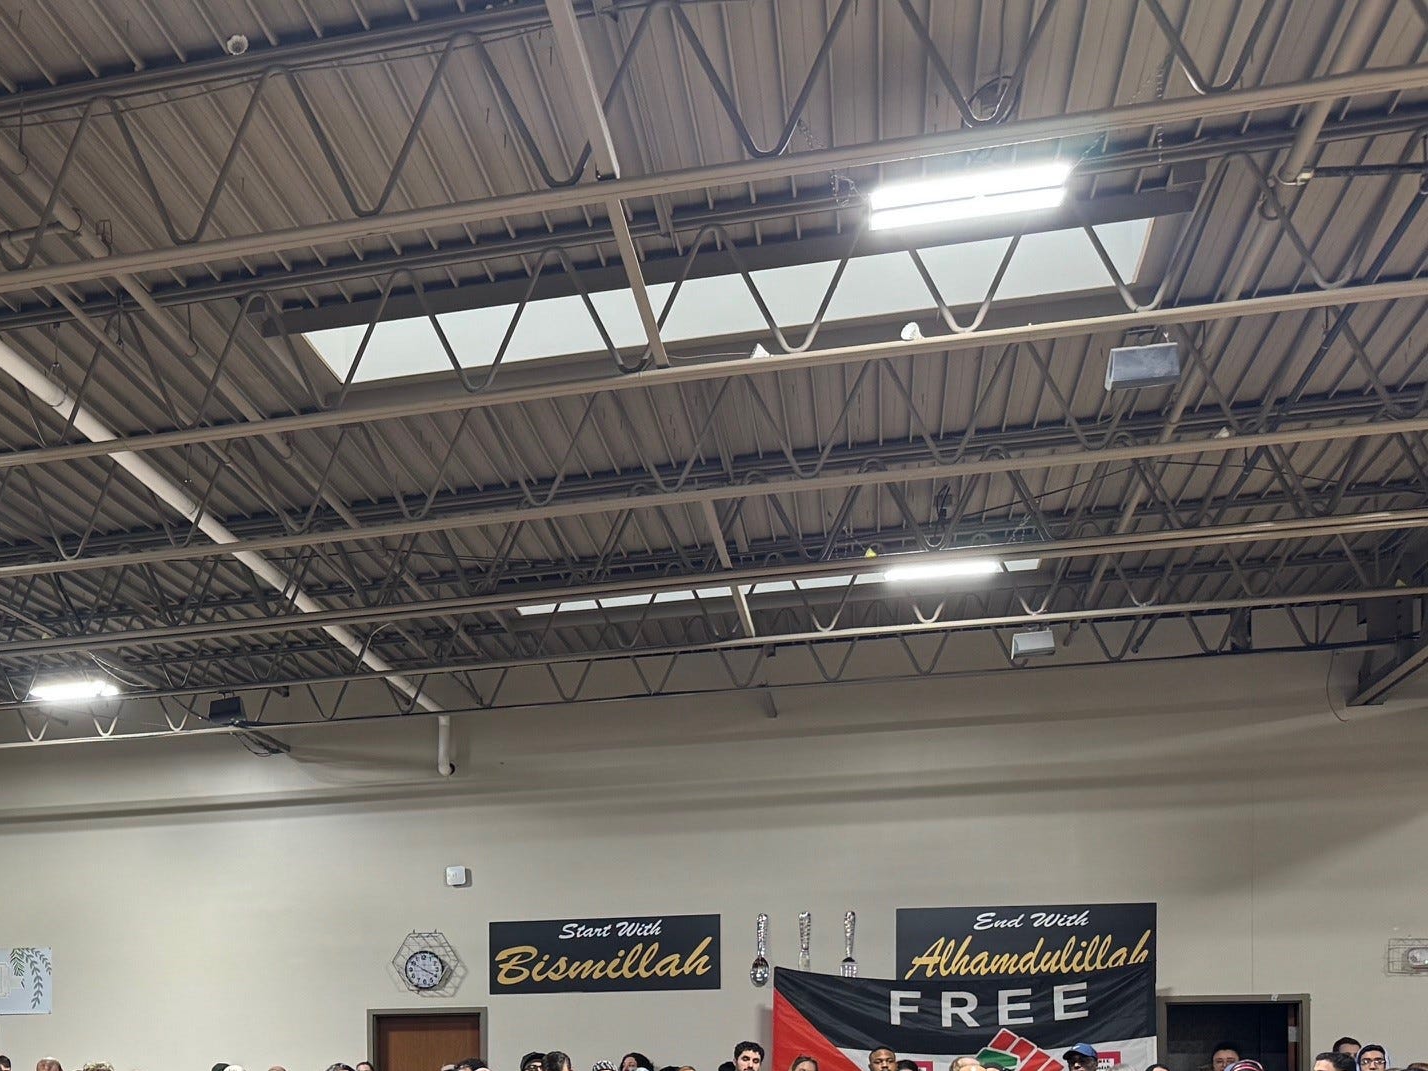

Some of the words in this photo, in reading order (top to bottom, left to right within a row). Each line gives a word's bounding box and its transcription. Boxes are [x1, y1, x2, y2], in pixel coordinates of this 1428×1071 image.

[558, 923, 611, 939] Start
[615, 919, 663, 938] With
[973, 911, 1025, 931] End
[1029, 909, 1090, 929] With
[494, 936, 713, 985] Bismillah
[904, 929, 1152, 980] Alhamdulillah
[890, 981, 1089, 1028] FREE
